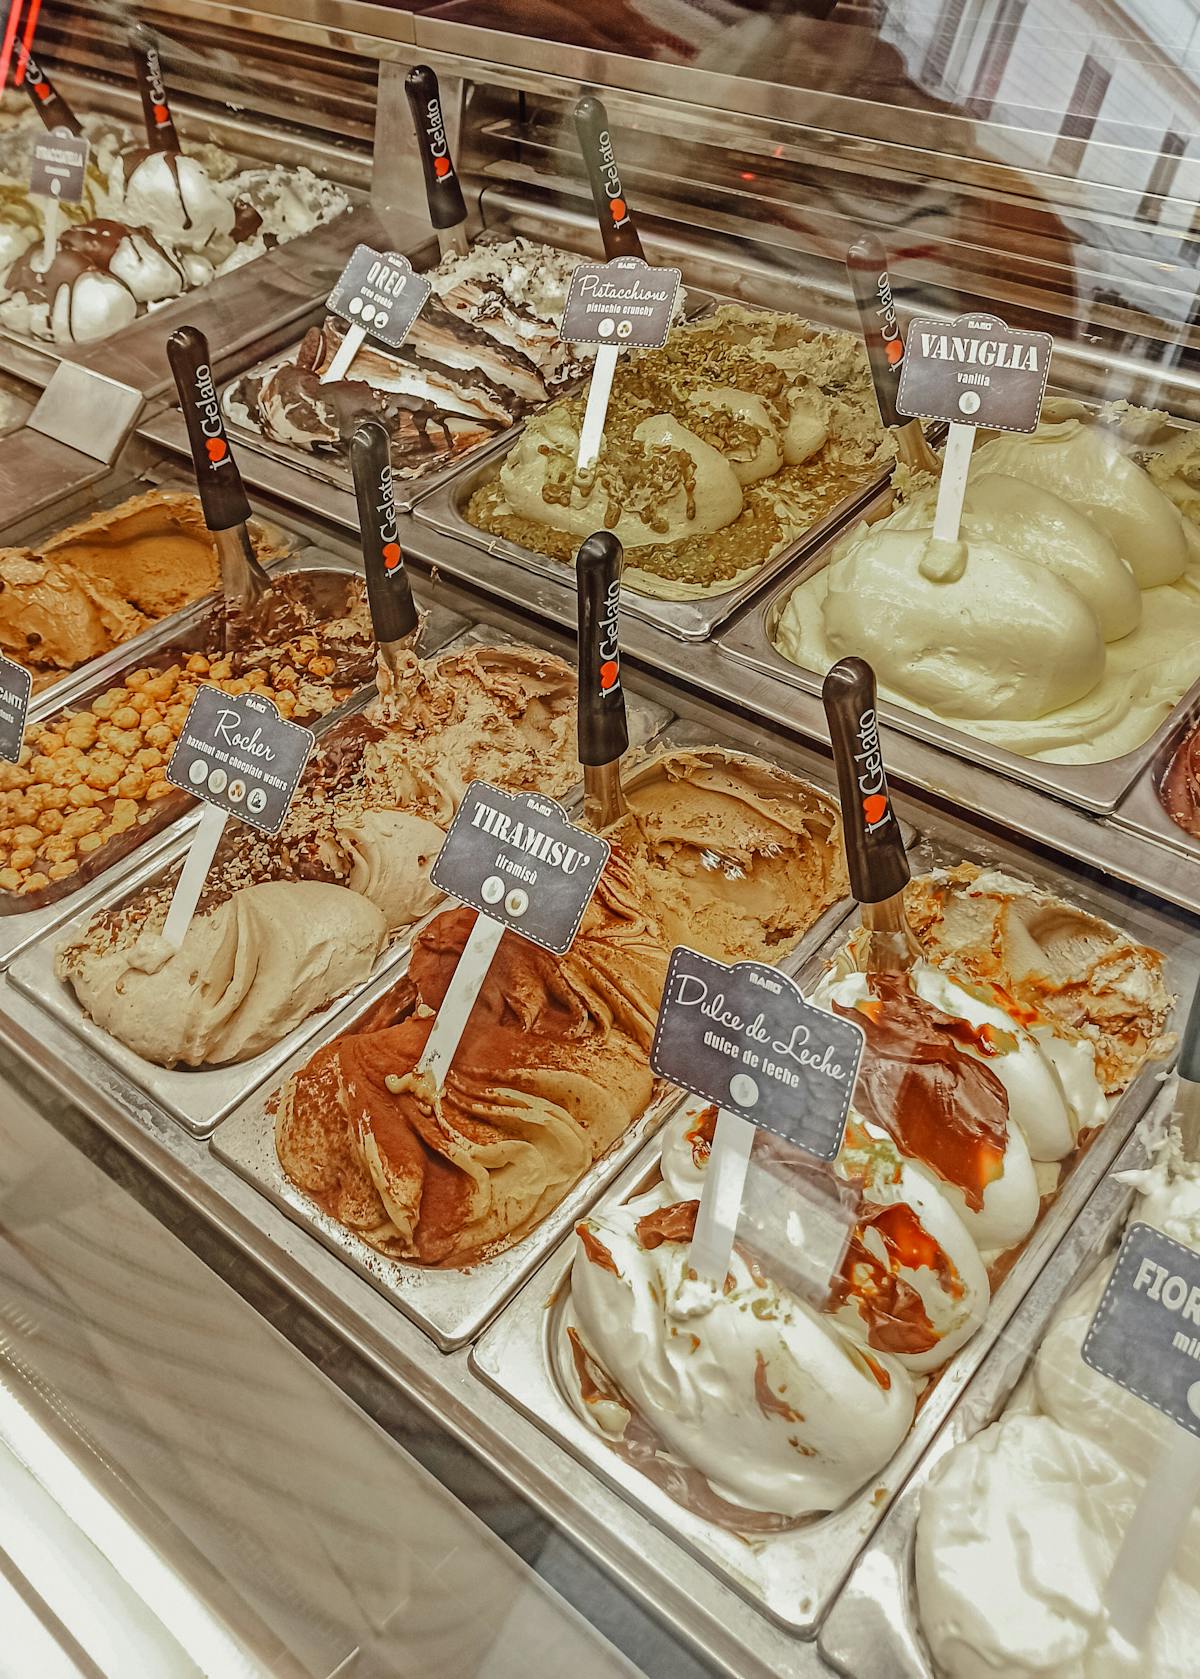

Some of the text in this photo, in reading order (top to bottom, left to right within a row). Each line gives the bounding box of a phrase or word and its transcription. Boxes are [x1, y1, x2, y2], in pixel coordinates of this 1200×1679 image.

[426, 99, 446, 158] Gelato
[598, 131, 622, 198] Gelato
[367, 262, 406, 298] OREO
[578, 274, 668, 302] Pistacchione
[586, 302, 654, 317] pistachio crunchy
[876, 272, 898, 341] Gelato
[921, 333, 1038, 372] VANIGLIA
[957, 372, 990, 386] vanilla
[195, 364, 222, 438] Gelato
[376, 464, 400, 543] Gelato
[598, 579, 620, 661] Gelato
[186, 735, 216, 756] hazelnut
[215, 750, 229, 762] and
[263, 772, 288, 791] wafers
[214, 709, 276, 762] Rocher
[854, 708, 884, 796] Gelato
[471, 802, 590, 875] TIRAMISU'
[675, 974, 846, 1080] Dulce de Leche
[704, 1030, 799, 1088] dulce de leche
[1133, 1258, 1200, 1326] FIOR
